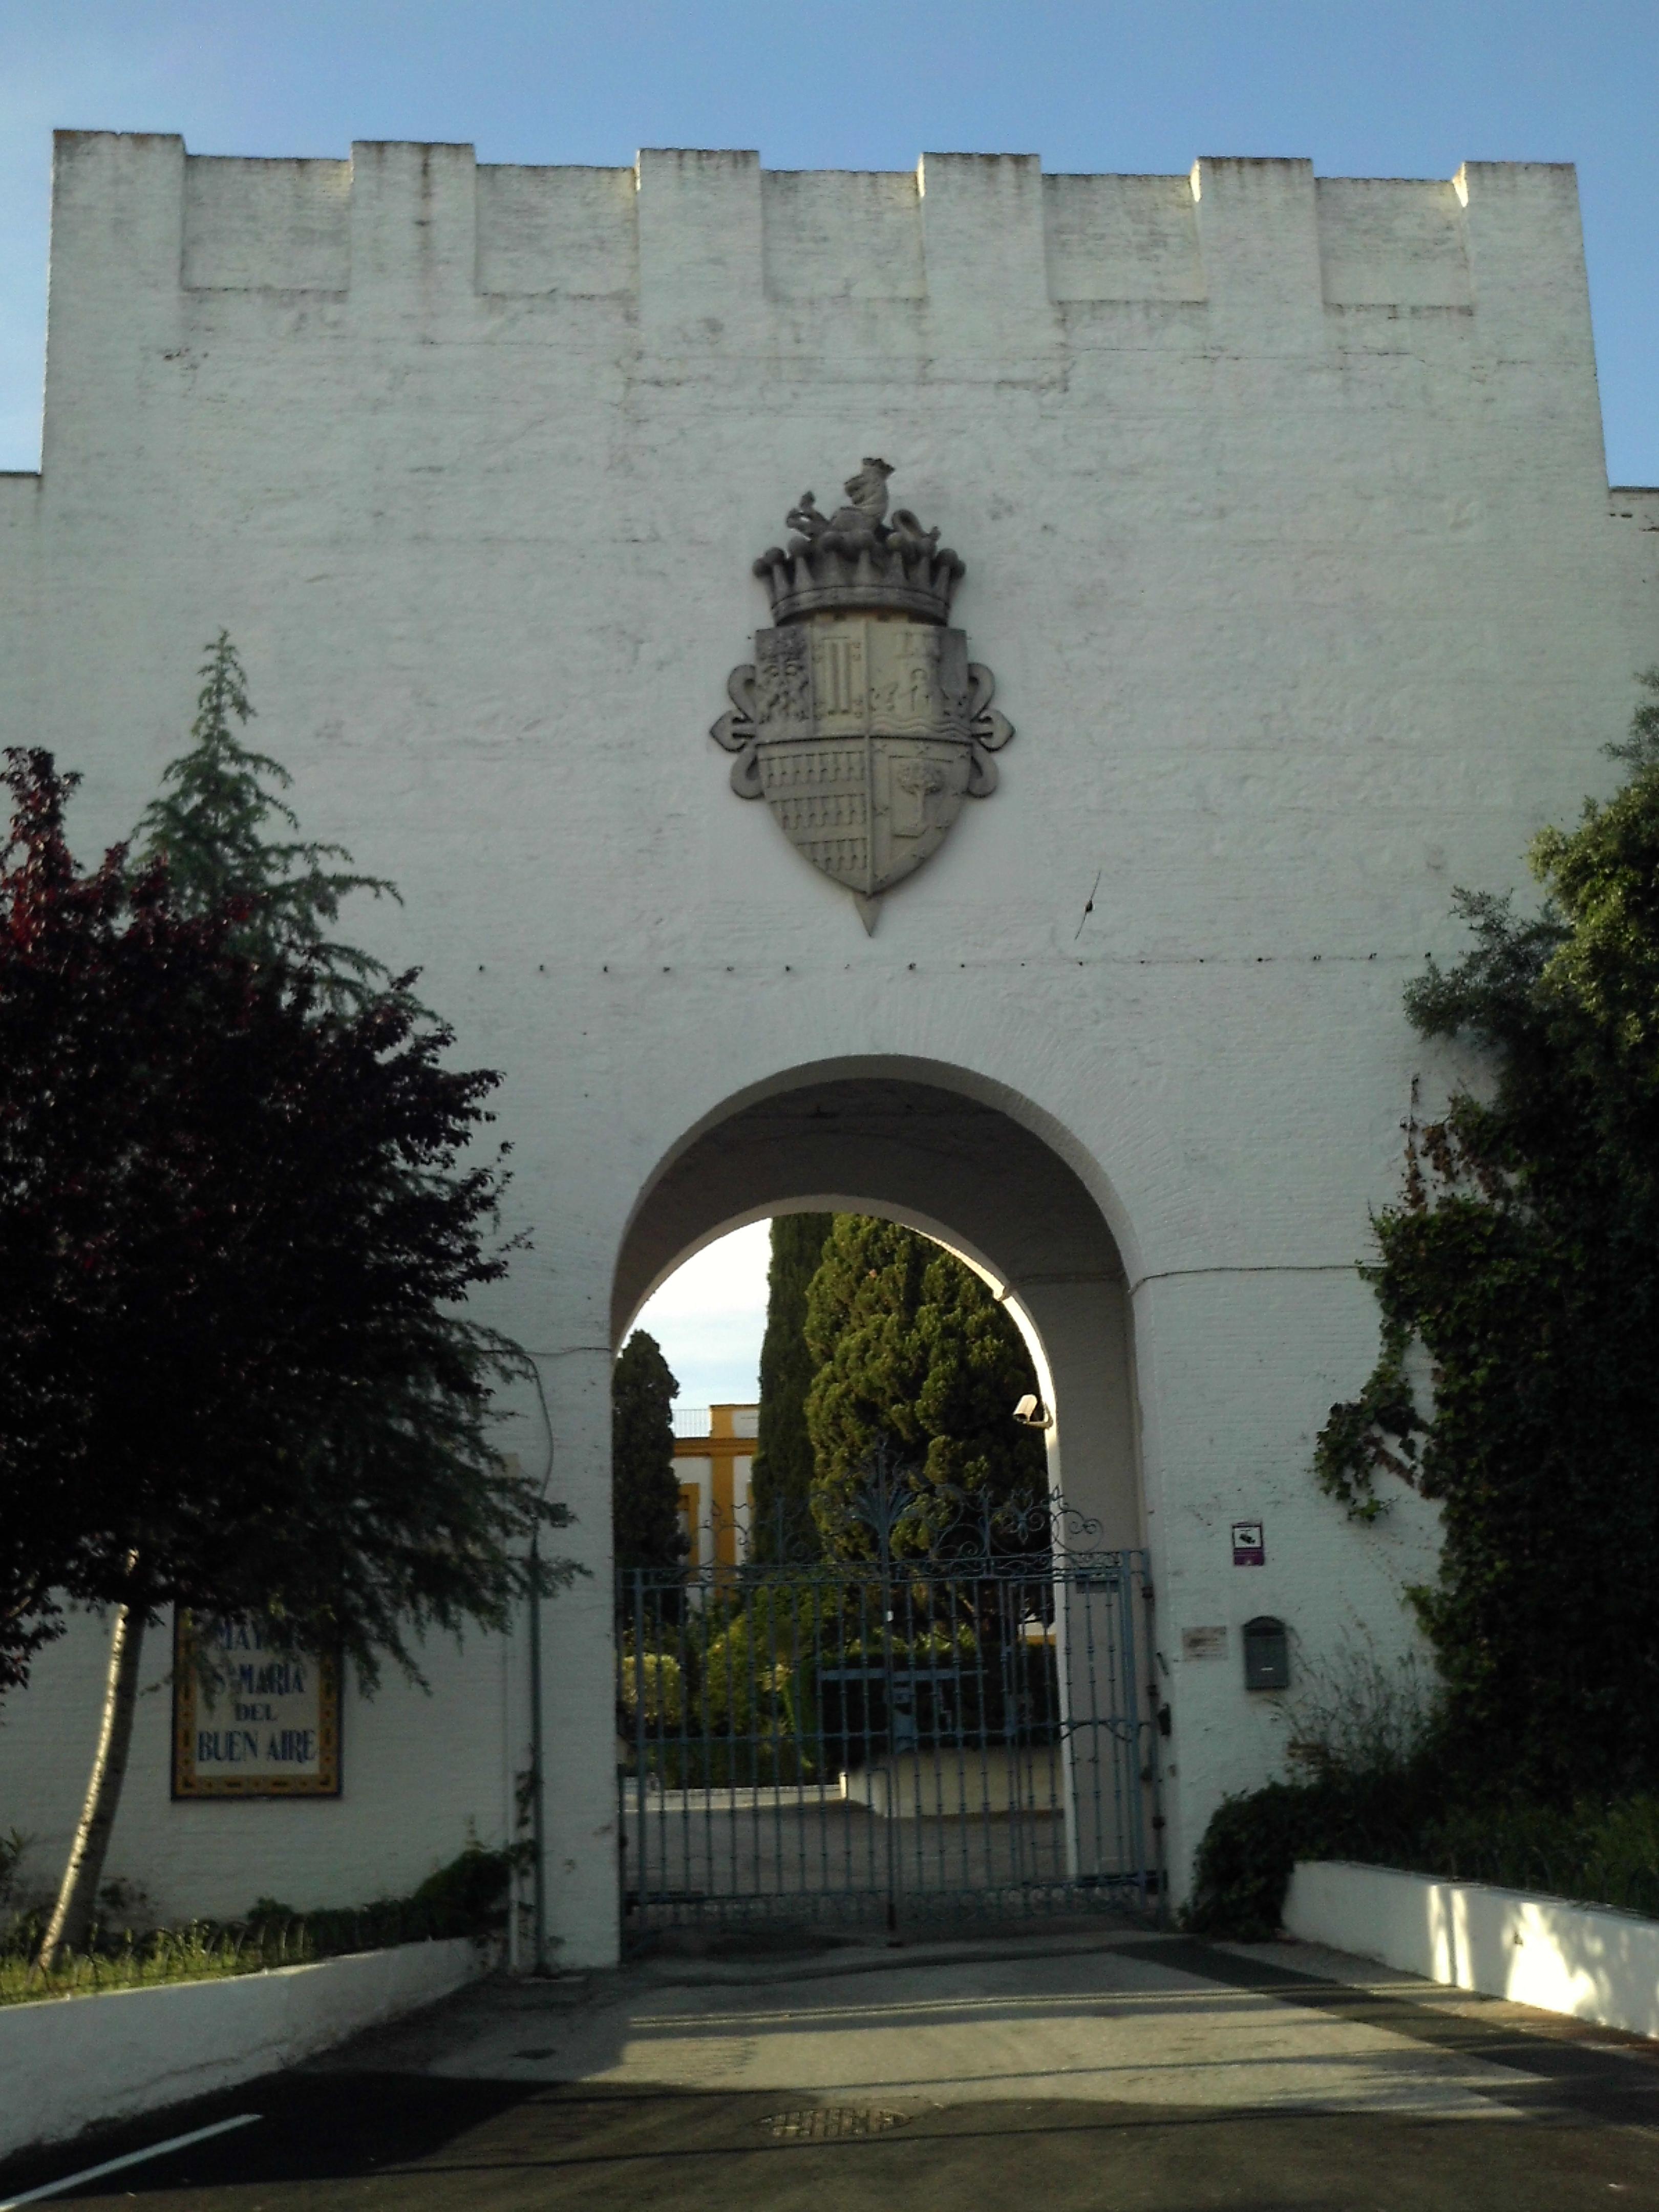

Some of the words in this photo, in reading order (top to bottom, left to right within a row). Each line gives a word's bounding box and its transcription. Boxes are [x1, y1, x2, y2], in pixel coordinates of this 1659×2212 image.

[235, 1703, 278, 1721] DEL
[197, 1730, 258, 1761] BUEN
[267, 1729, 315, 1763] AIRE
